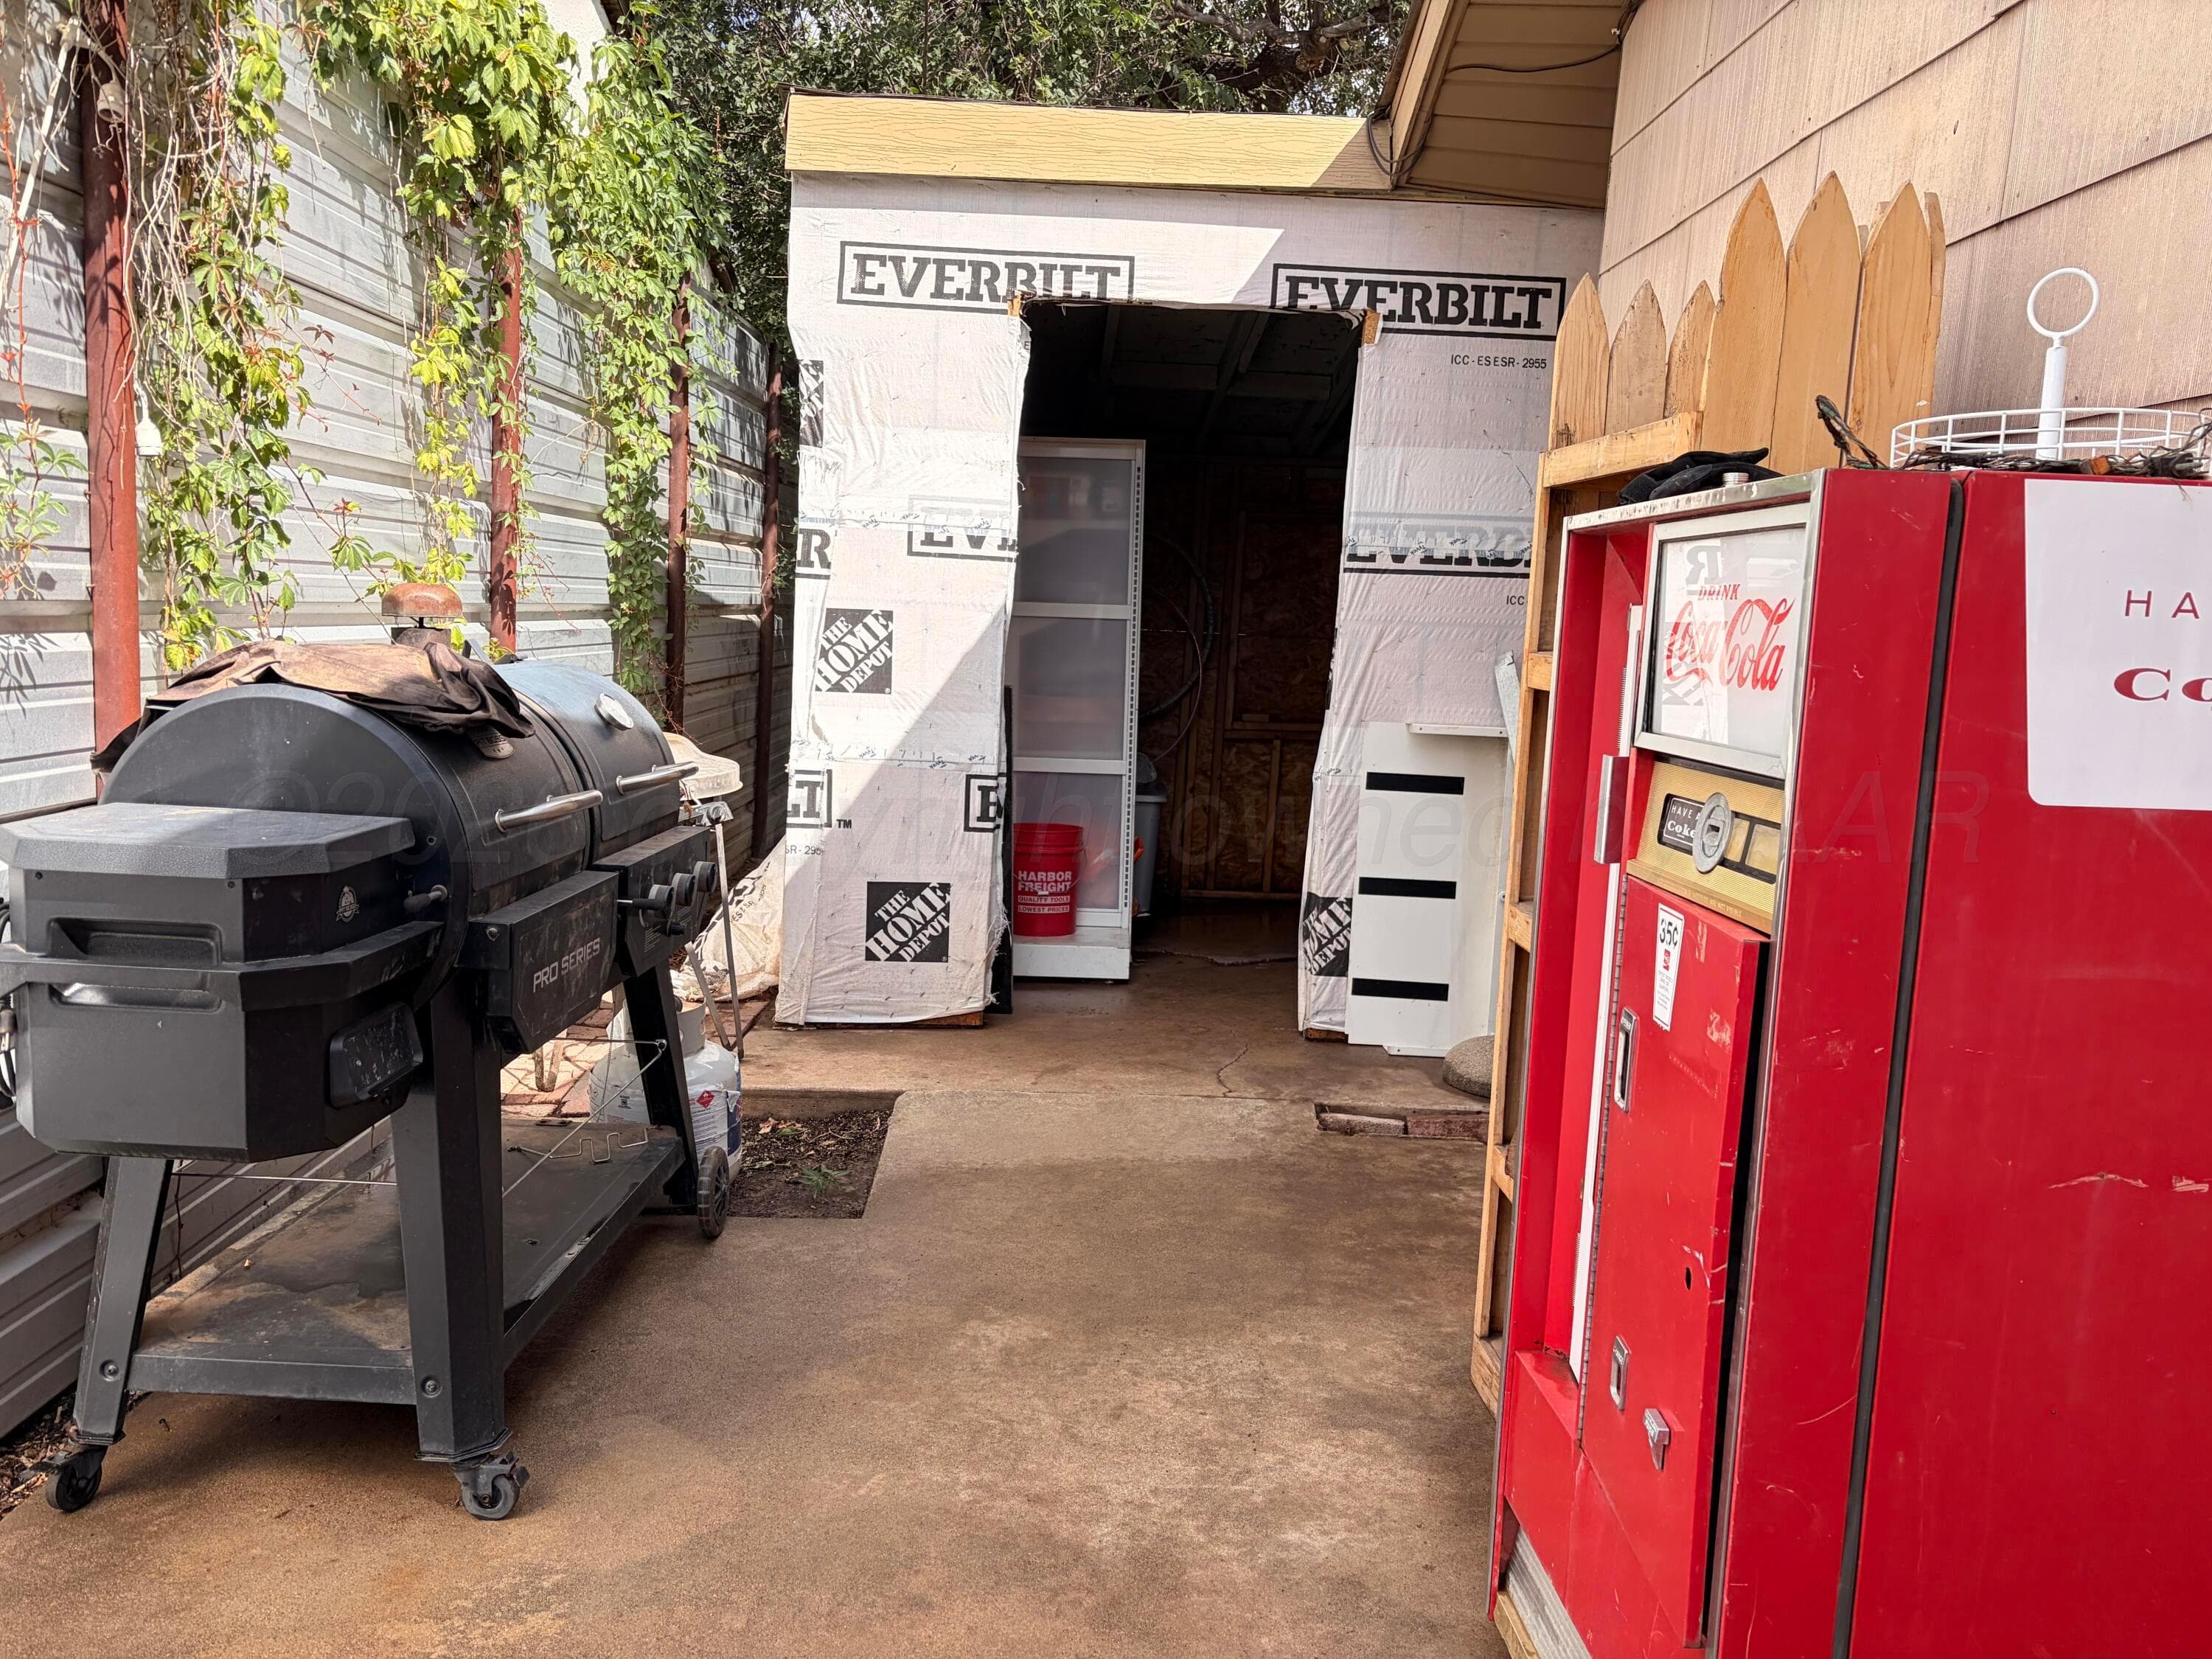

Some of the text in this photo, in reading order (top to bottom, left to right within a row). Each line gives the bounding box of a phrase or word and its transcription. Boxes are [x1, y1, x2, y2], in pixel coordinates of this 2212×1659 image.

[851, 254, 1121, 302] EVERBILT
[1286, 276, 1552, 329] EVERBILT
[1698, 584, 1740, 601] DRINK
[815, 608, 894, 692] HOME
[818, 616, 853, 650] THE
[839, 641, 892, 693] DEPOT
[1672, 804, 1693, 818] HAVE
[1667, 820, 1696, 838] Coke
[1018, 870, 1072, 882] HARBOR
[1018, 881, 1071, 893] FREIGHT
[874, 889, 911, 919] THE
[866, 883, 950, 961] HOME
[897, 911, 950, 962] DEPOT
[1659, 917, 1679, 950] 35¢
[533, 937, 600, 993] PRO SERIES
